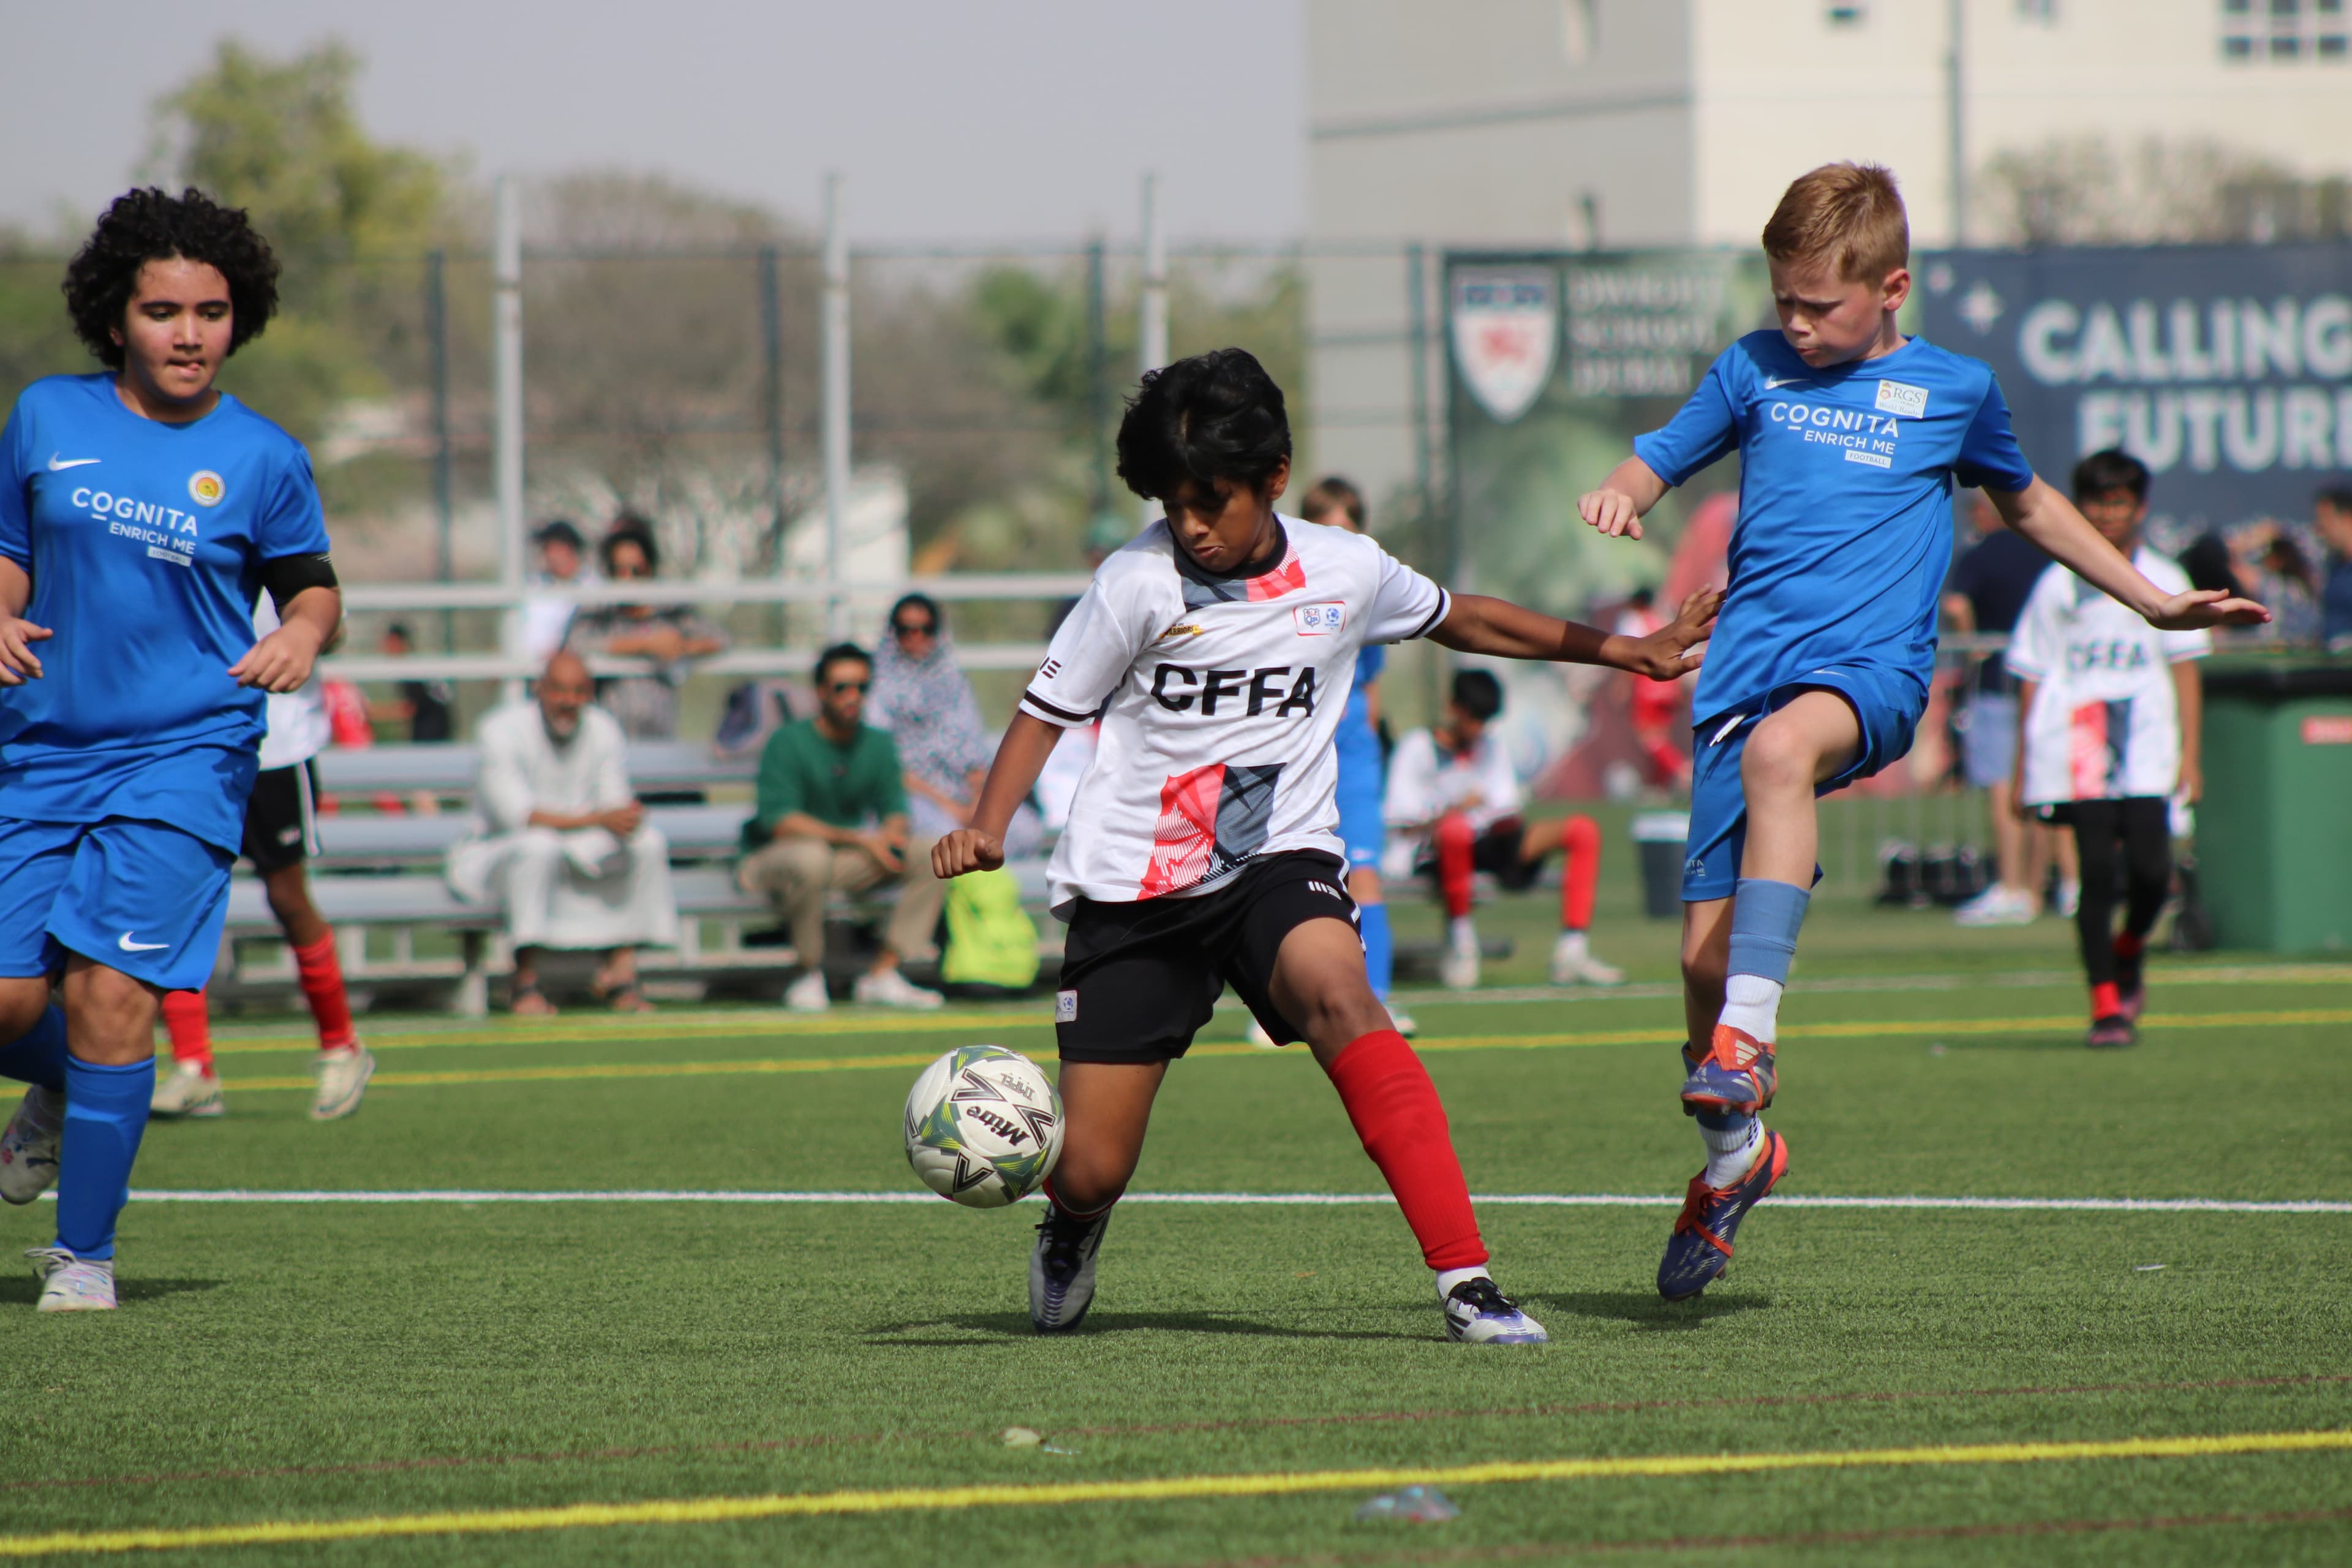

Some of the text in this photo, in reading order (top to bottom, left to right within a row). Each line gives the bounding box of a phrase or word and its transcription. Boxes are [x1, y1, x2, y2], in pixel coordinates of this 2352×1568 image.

[2020, 298, 2352, 385] CALLING
[1893, 388, 1922, 404] RGS
[1771, 402, 1899, 437] COGNITA
[1804, 430, 1896, 454] ENRICH ME
[1849, 453, 1887, 466] FOOTBALL
[72, 488, 198, 537] COGNITA
[110, 522, 196, 555] ENRICH ME
[1151, 663, 1315, 718] CFFA
[1000, 1073, 1035, 1101] IMPEL
[967, 1106, 1030, 1146] Mitre
